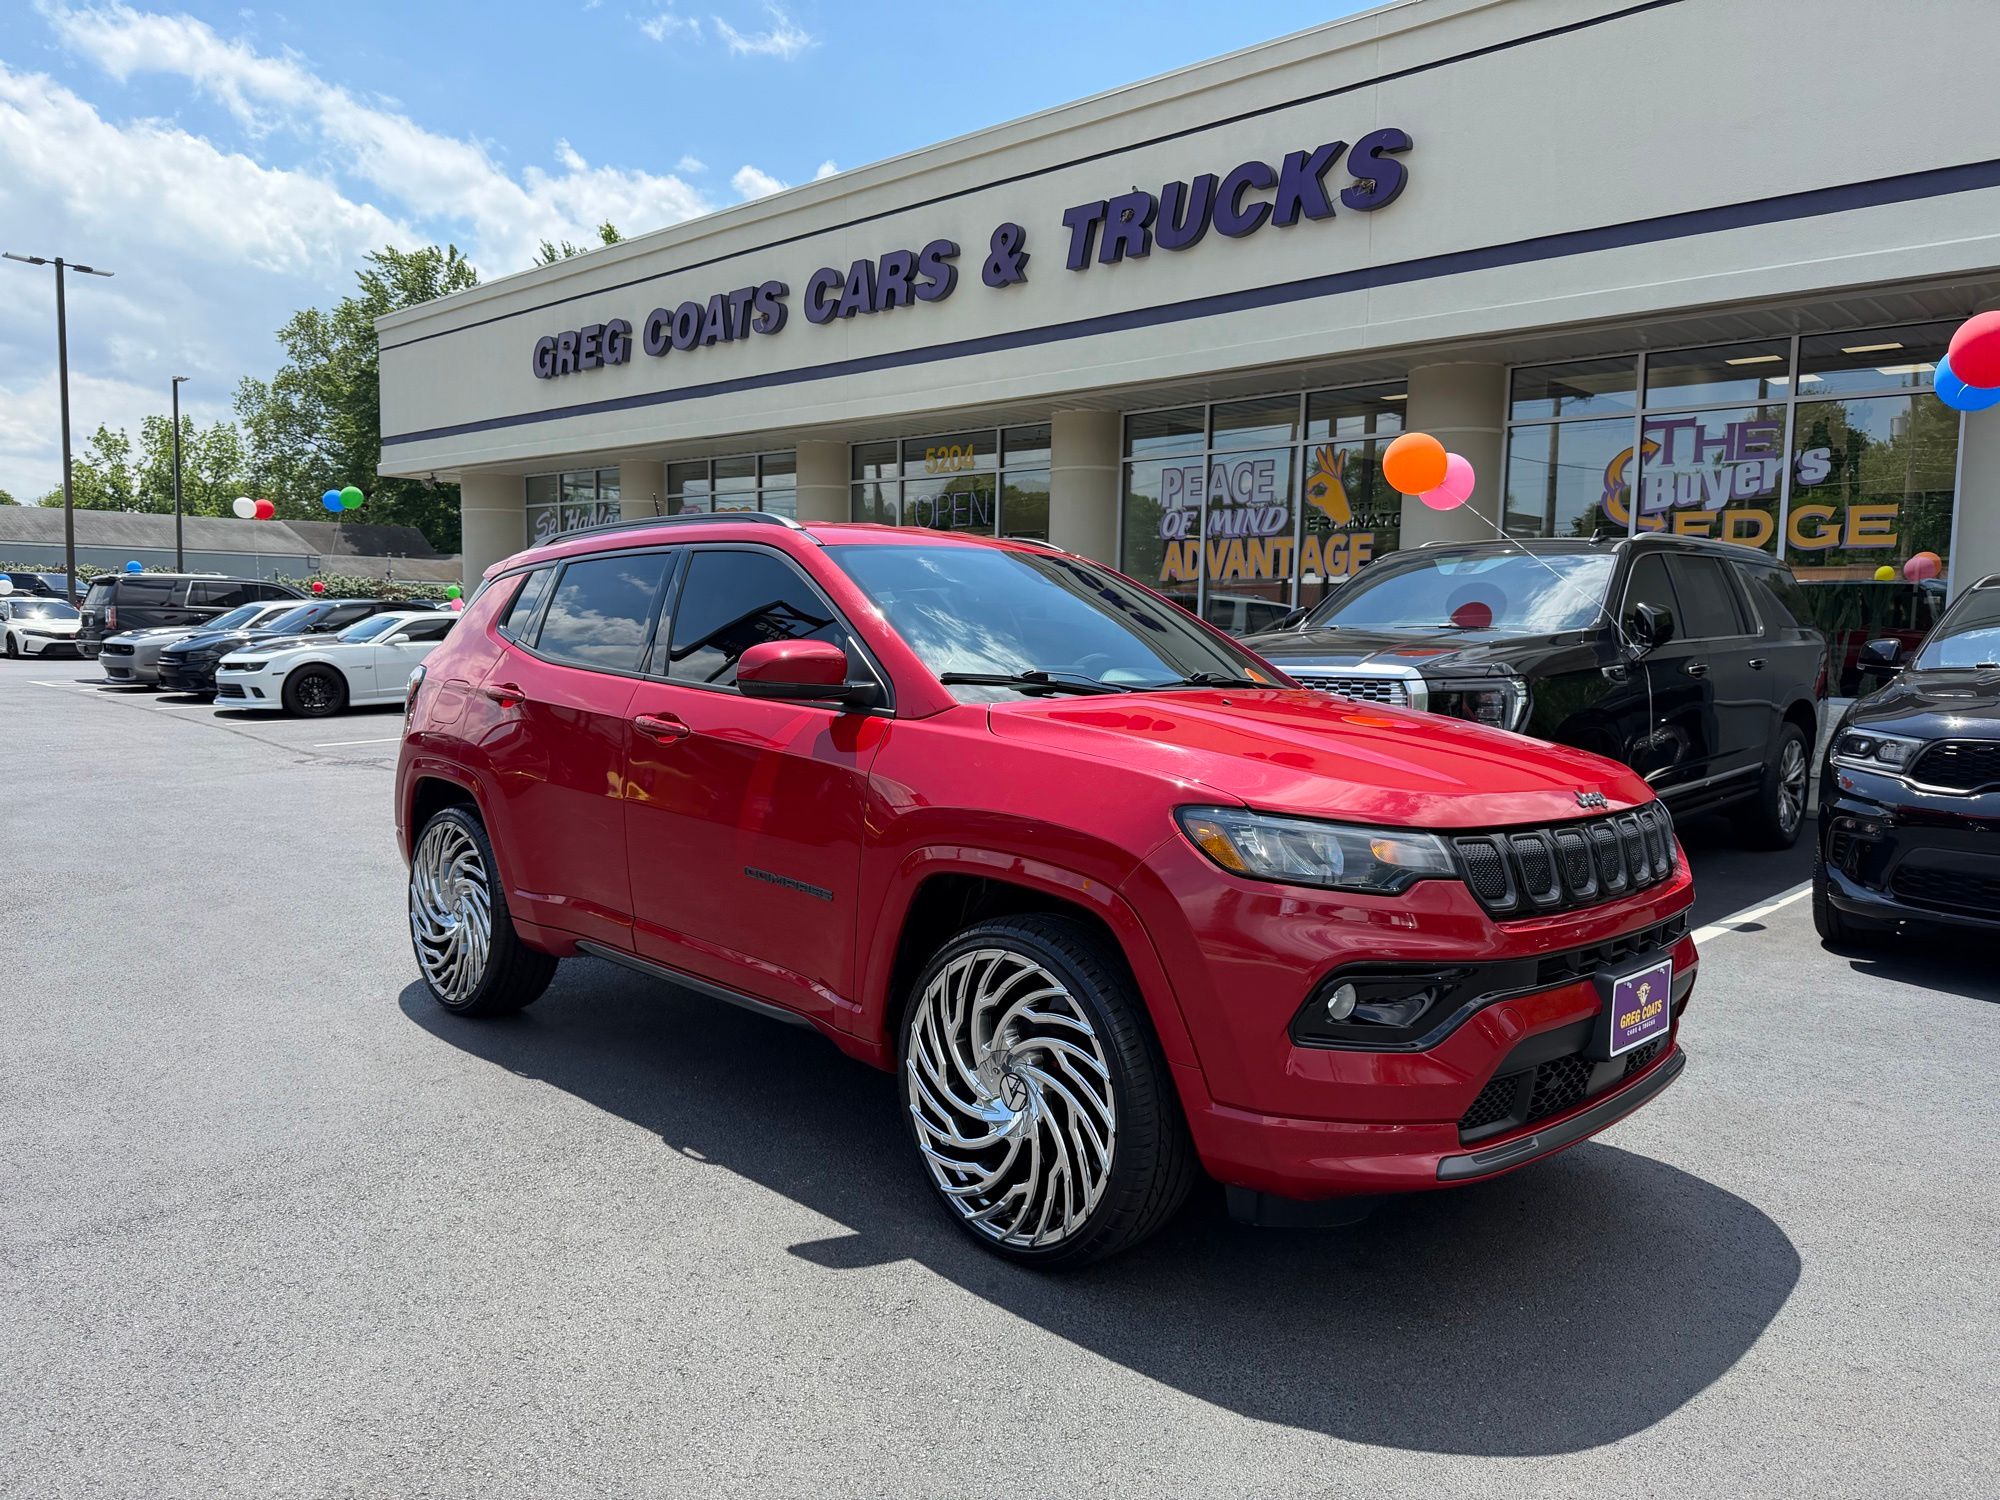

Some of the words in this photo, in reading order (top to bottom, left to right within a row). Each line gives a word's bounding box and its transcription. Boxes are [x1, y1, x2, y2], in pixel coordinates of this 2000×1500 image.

[533, 319, 631, 379] GREG
[643, 281, 789, 357] COATS
[804, 239, 961, 325] CARS
[982, 222, 1030, 289] &
[1062, 128, 1413, 272] TRUCKS
[924, 443, 976, 474] 5204
[1645, 416, 1780, 466] THE
[1160, 459, 1275, 507] PEACE
[534, 512, 556, 542] Se
[915, 491, 988, 529] OPEN
[1159, 509, 1199, 540] OF
[1206, 507, 1289, 539] MIND
[1672, 503, 1899, 550] EDGE
[1158, 533, 1375, 582] ADVANTAGE
[1620, 1009, 1641, 1030] GREG
[1641, 999, 1663, 1021] COATS
